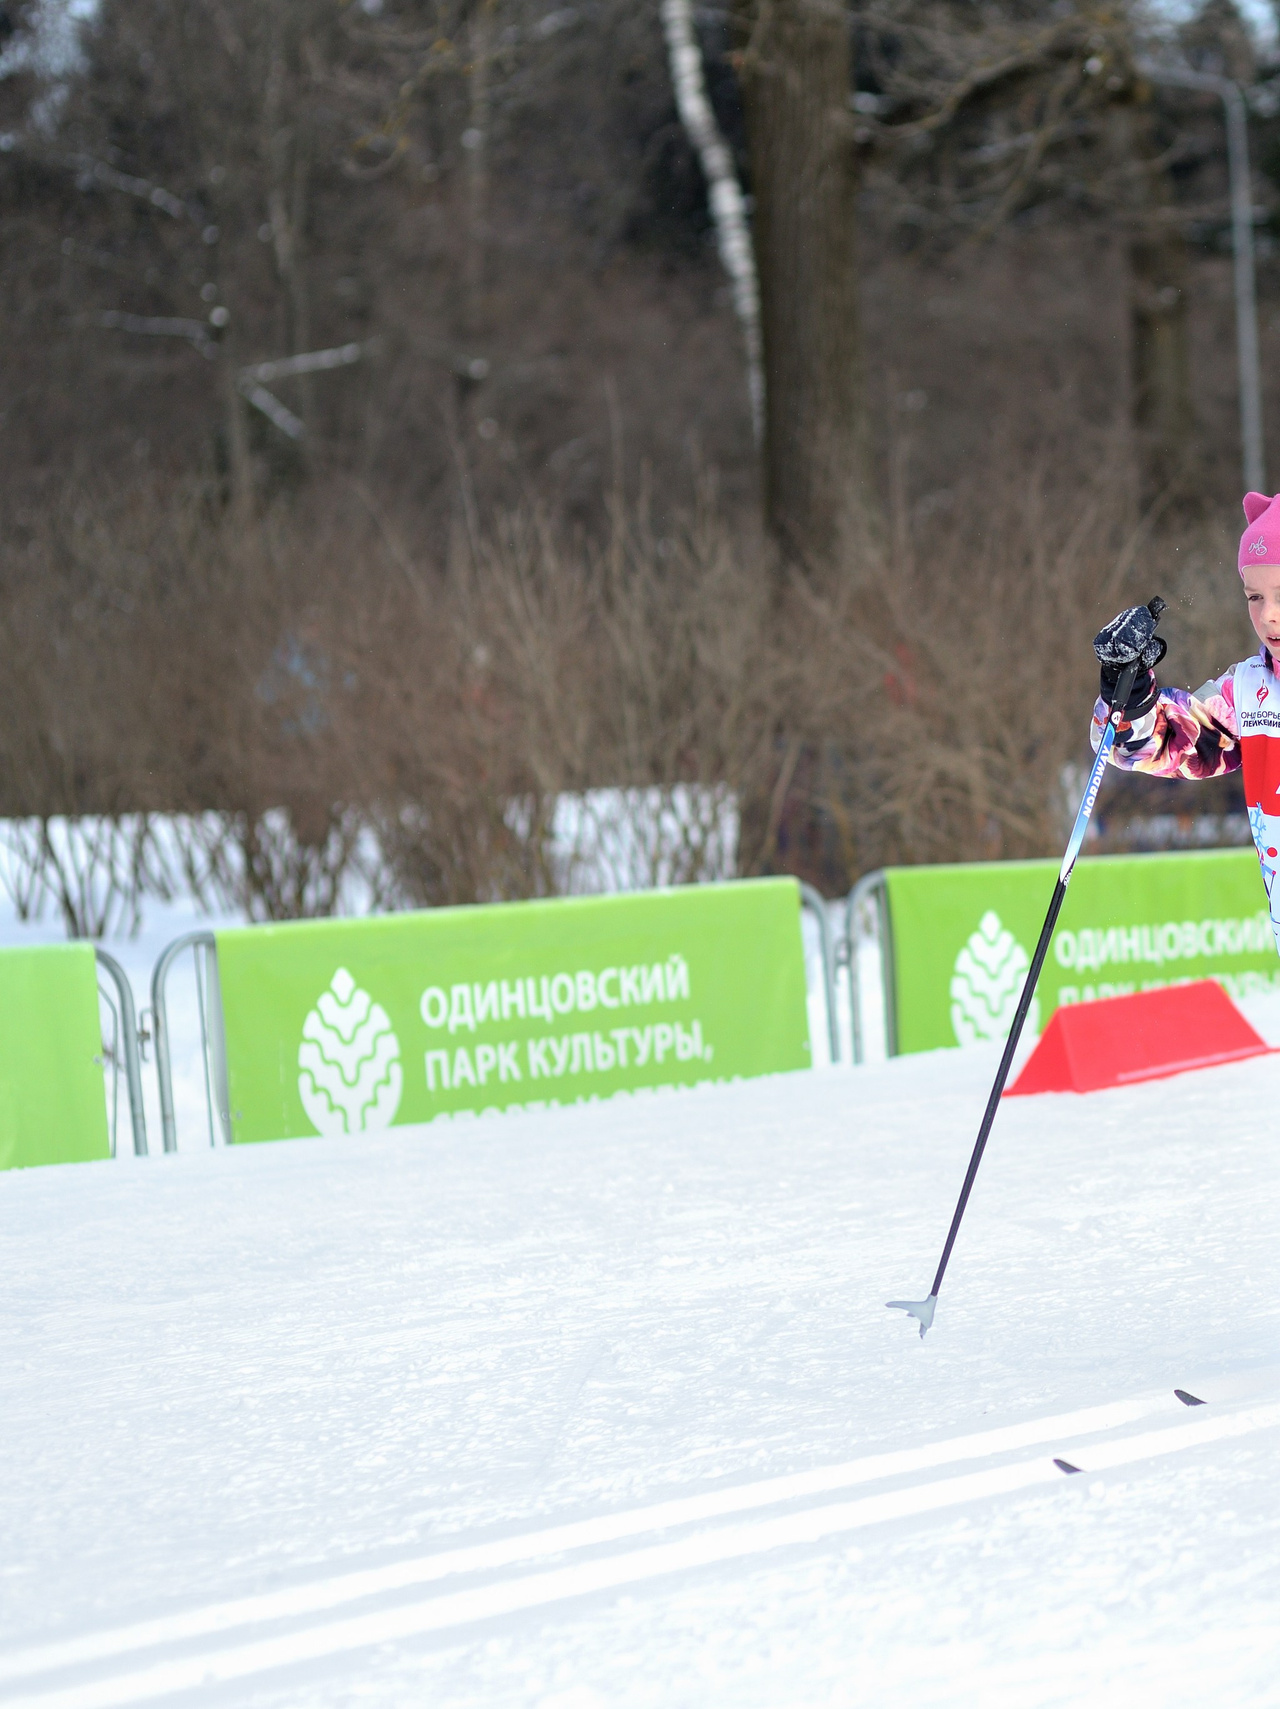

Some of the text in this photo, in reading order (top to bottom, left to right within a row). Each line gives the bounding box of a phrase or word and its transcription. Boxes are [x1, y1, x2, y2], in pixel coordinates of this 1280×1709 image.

[1083, 744, 1110, 819] NORDWAY
[1055, 910, 1274, 974] ОДИНЦОВСКИЙ
[420, 954, 690, 1034] ОДИНЦОВСКИЙ
[425, 1019, 713, 1091] ПАРК КУЛЬТУРЫ,
